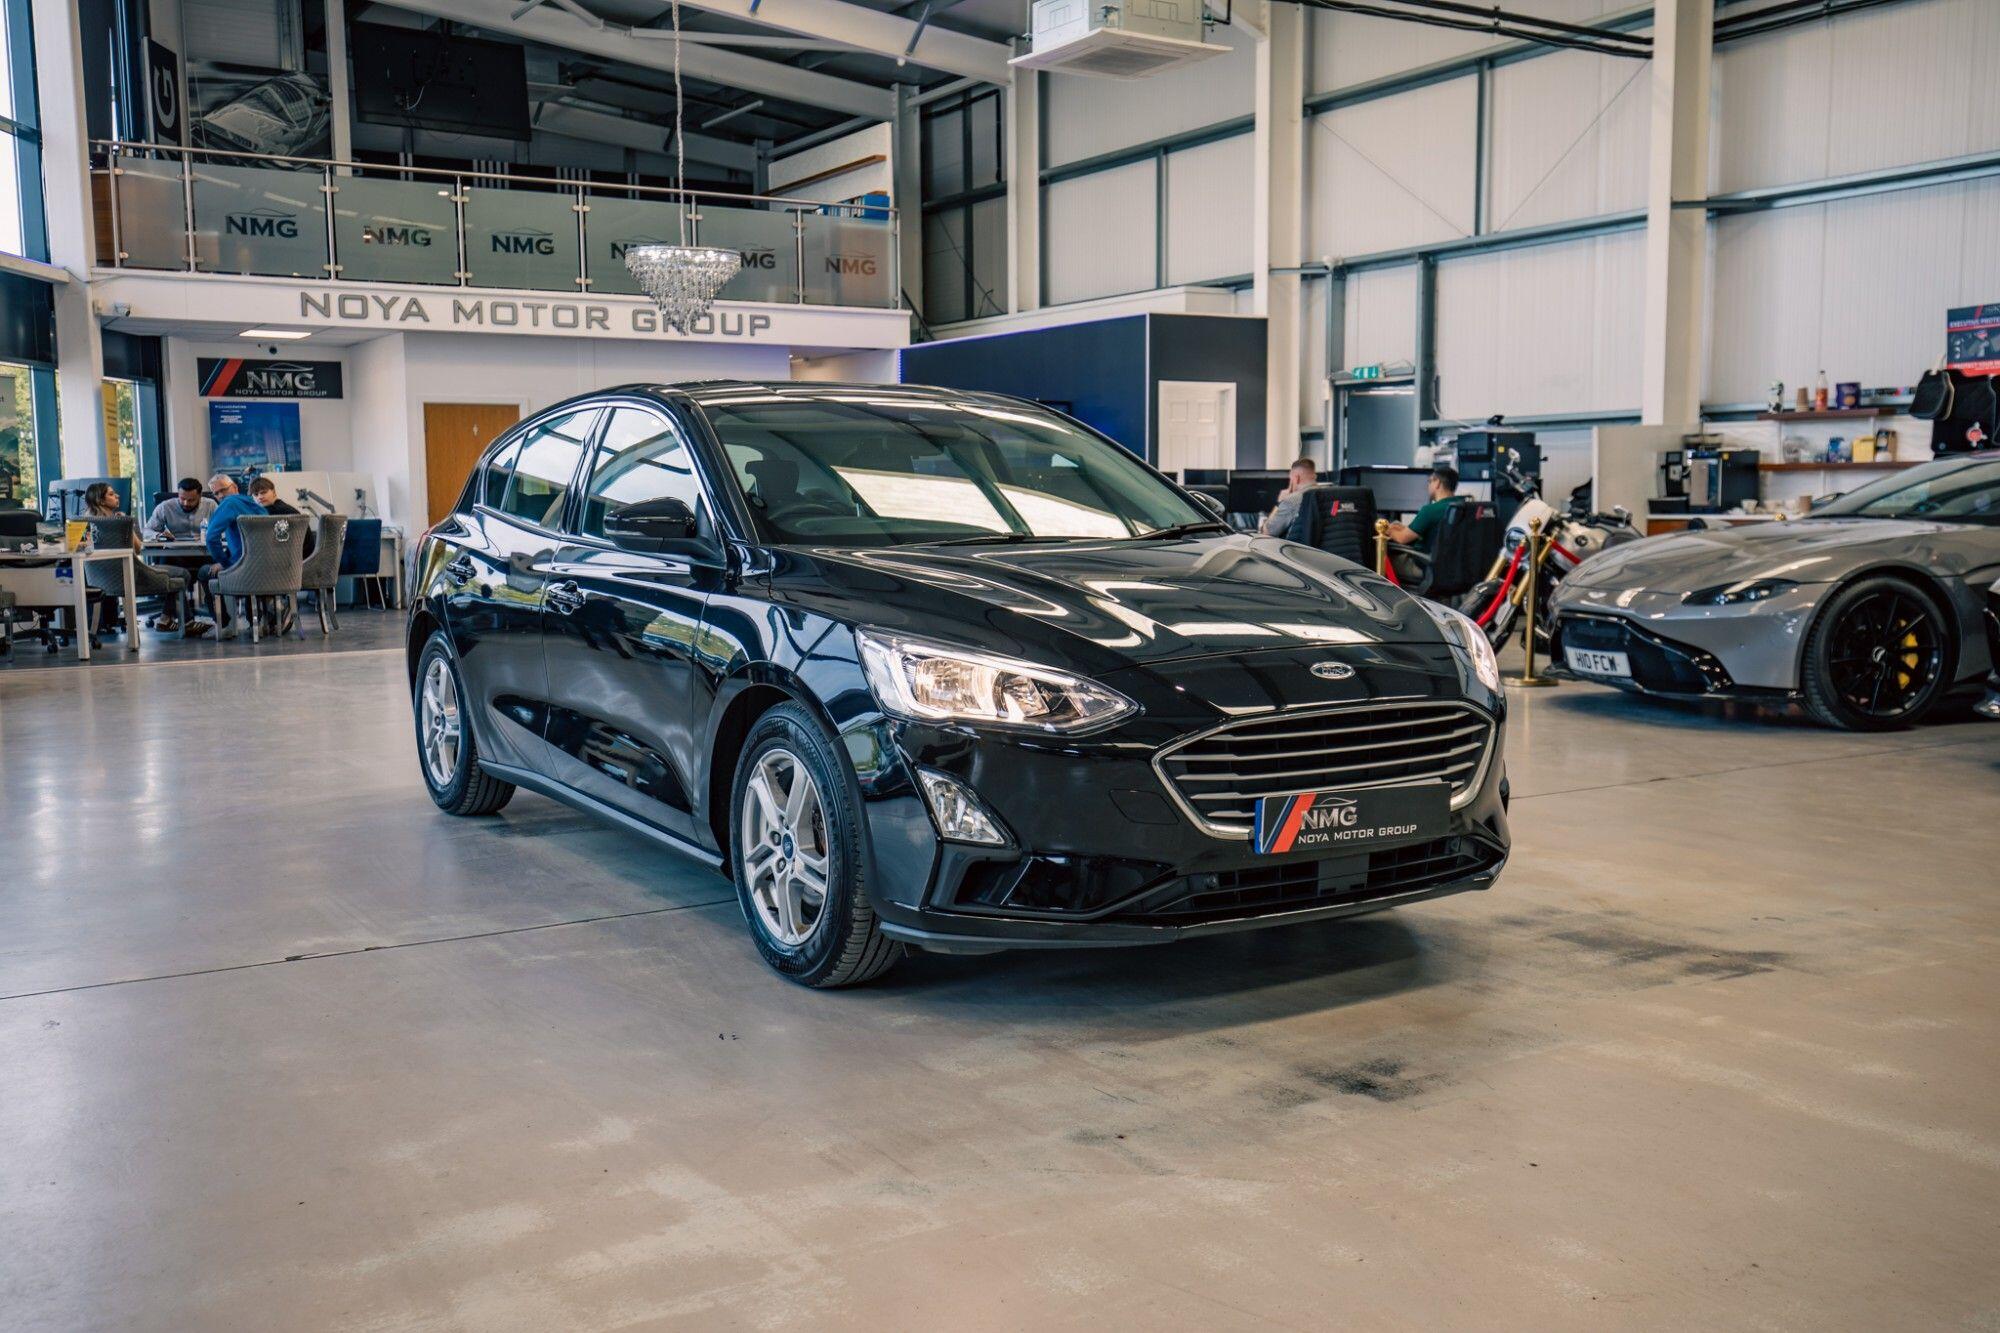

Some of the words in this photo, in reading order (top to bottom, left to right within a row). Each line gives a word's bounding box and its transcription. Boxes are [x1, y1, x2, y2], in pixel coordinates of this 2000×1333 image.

[226, 215, 298, 238] NMG
[364, 226, 431, 247] NMG
[492, 234, 554, 255] NMG
[825, 258, 876, 275] NMG
[300, 291, 430, 322] NOYA
[453, 300, 610, 330] MOTOR
[246, 371, 316, 390] NMG
[1300, 806, 1358, 830] NMG
[1298, 834, 1329, 844] NOYA
[1334, 829, 1374, 840] MOTOR
[1378, 824, 1417, 835] GROUP
